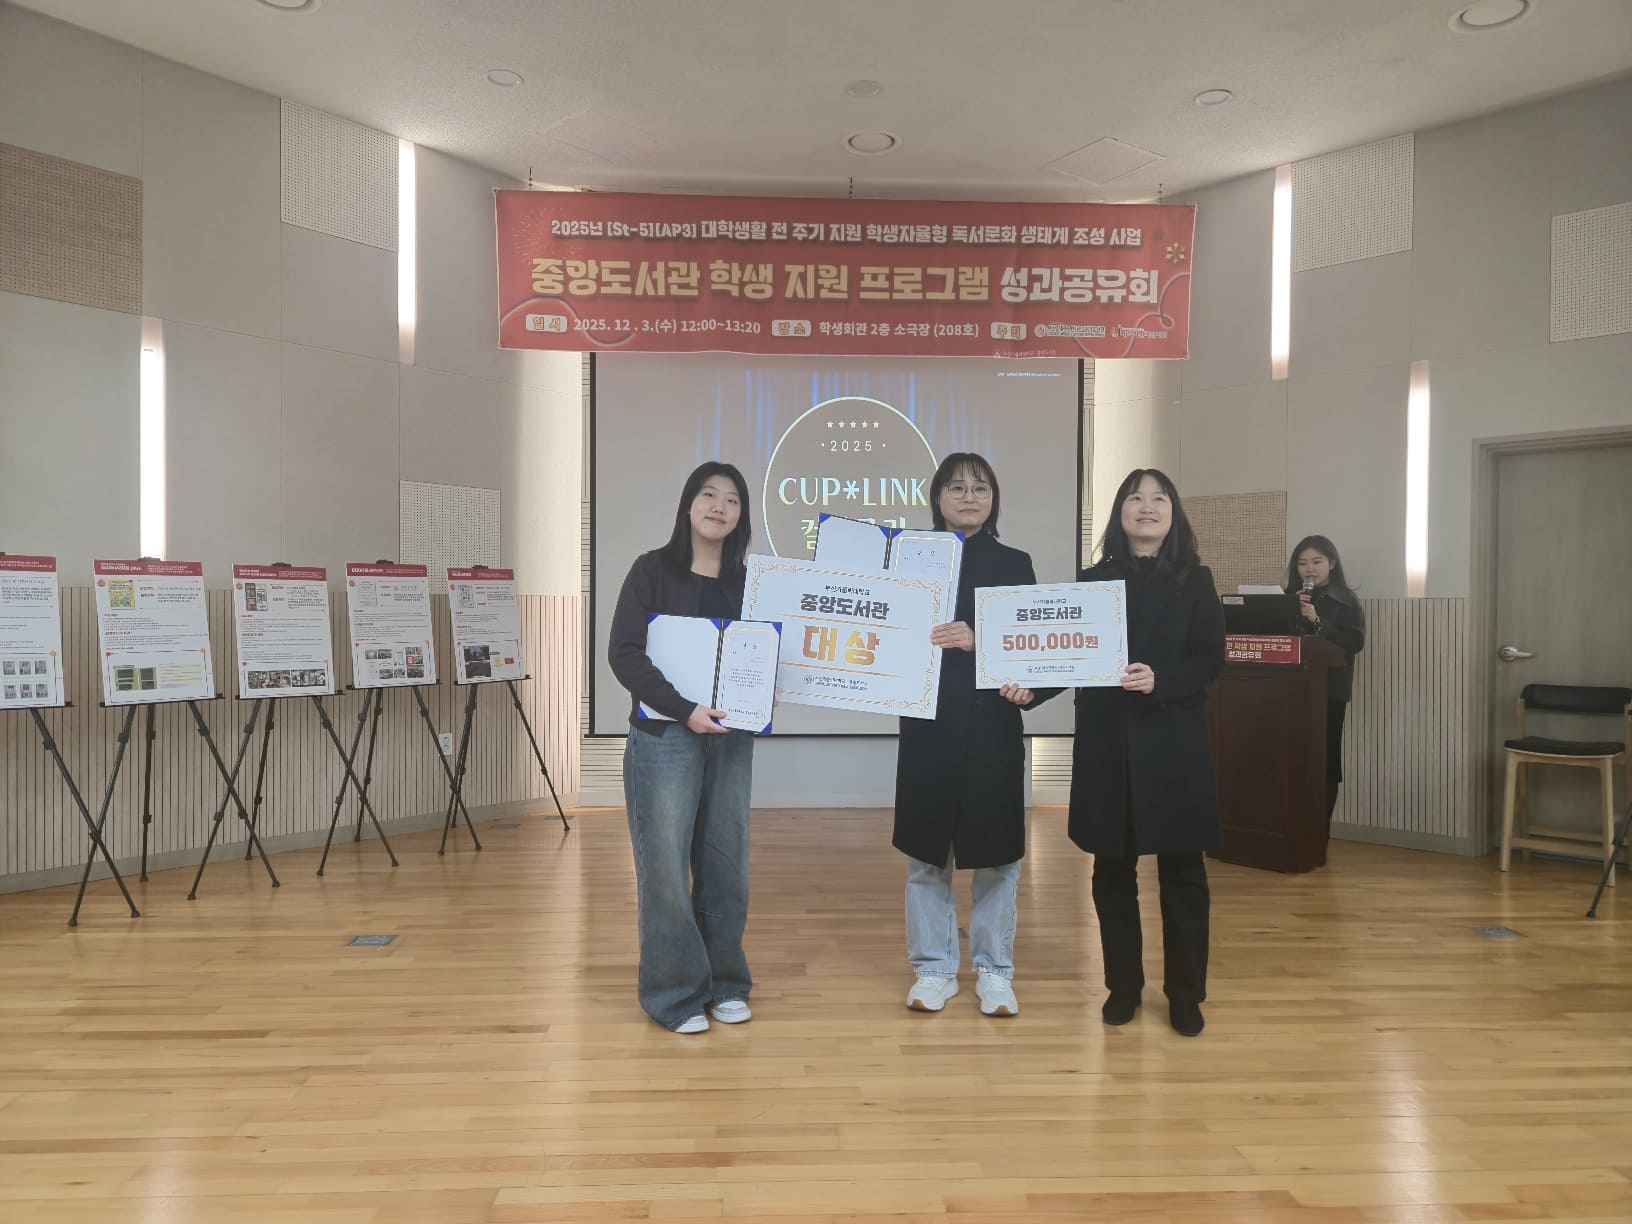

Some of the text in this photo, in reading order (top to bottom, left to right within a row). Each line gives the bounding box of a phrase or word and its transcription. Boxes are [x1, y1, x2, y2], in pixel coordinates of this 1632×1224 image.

[551, 220, 603, 237] 2025년
[701, 220, 767, 240] 대학생활
[771, 221, 788, 240] 전
[792, 222, 825, 241] 주기
[829, 223, 862, 242] 지원
[866, 223, 947, 243] 학생자율형
[952, 225, 1017, 244] 독서문화
[1021, 226, 1068, 245] 생태계
[1073, 227, 1105, 246] 조성
[1109, 228, 1141, 246] 사업
[531, 257, 1159, 304] 중앙도서관 학생 지원 프로그램 성과공유회
[681, 319, 761, 334] 12:00~13:20
[819, 321, 868, 336] 학생회관
[870, 322, 889, 336] 2층
[893, 322, 930, 337] 소극장
[934, 322, 980, 338] (208호)
[830, 440, 872, 452] 2025
[800, 593, 890, 620] 중앙도서관
[1016, 606, 1082, 622] 중앙도서관
[802, 625, 881, 666] 대상
[1002, 631, 1099, 652] 500,000원
